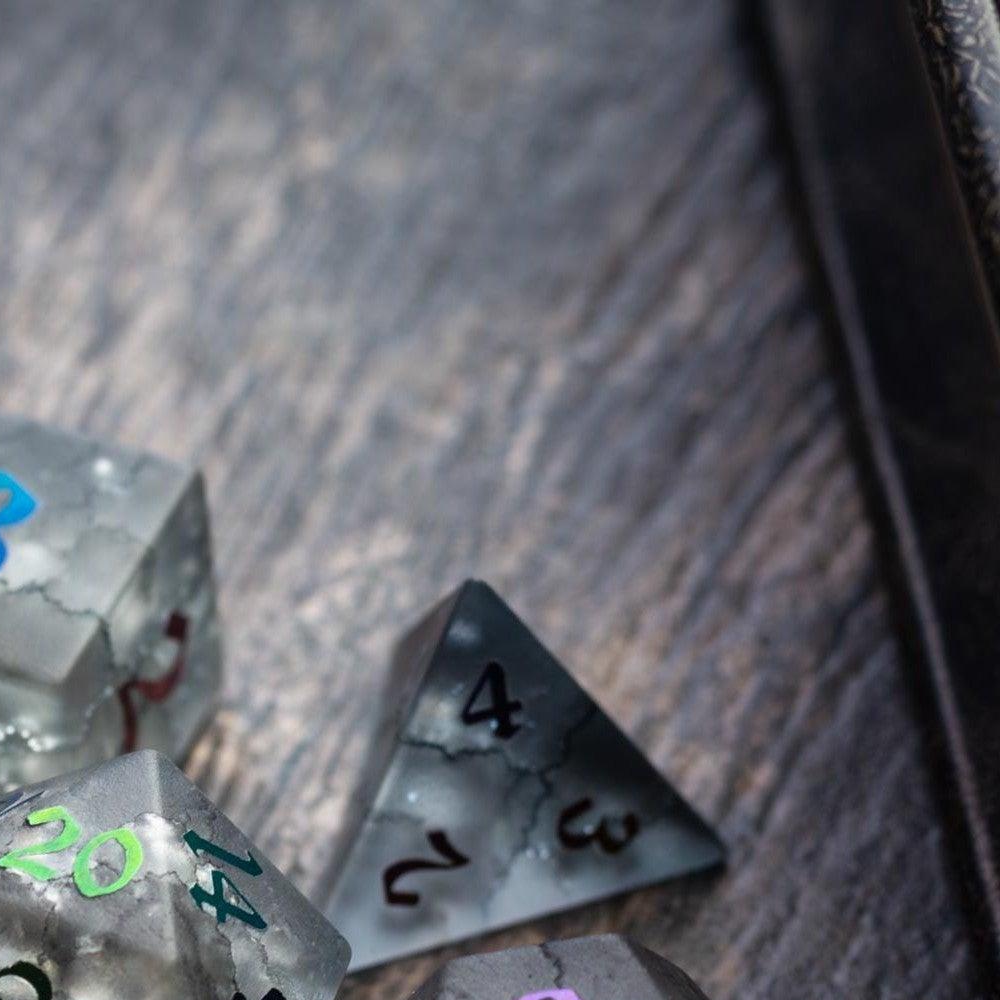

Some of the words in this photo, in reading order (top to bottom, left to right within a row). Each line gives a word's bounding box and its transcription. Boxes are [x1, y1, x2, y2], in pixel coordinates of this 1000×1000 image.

[461, 661, 523, 739] 4
[557, 799, 641, 854] 3
[382, 830, 471, 907] 2
